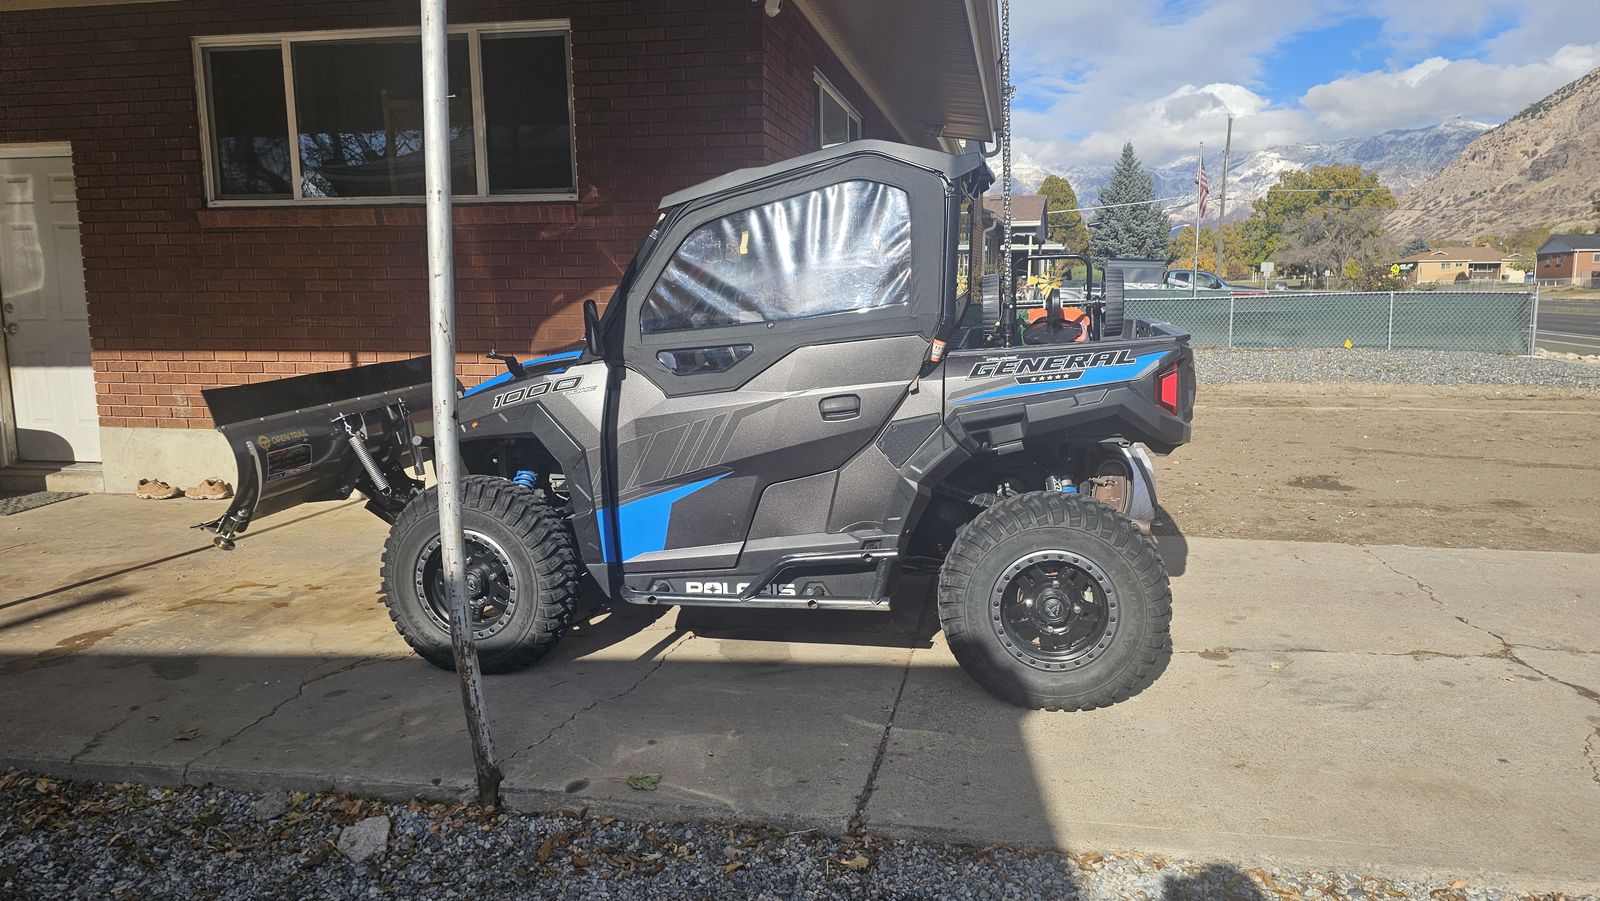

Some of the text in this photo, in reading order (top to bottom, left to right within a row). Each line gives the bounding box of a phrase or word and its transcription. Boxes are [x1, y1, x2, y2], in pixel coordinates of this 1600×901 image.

[965, 349, 1137, 381] GENERAL
[492, 374, 584, 410] 1000
[271, 432, 289, 444] OPEN
